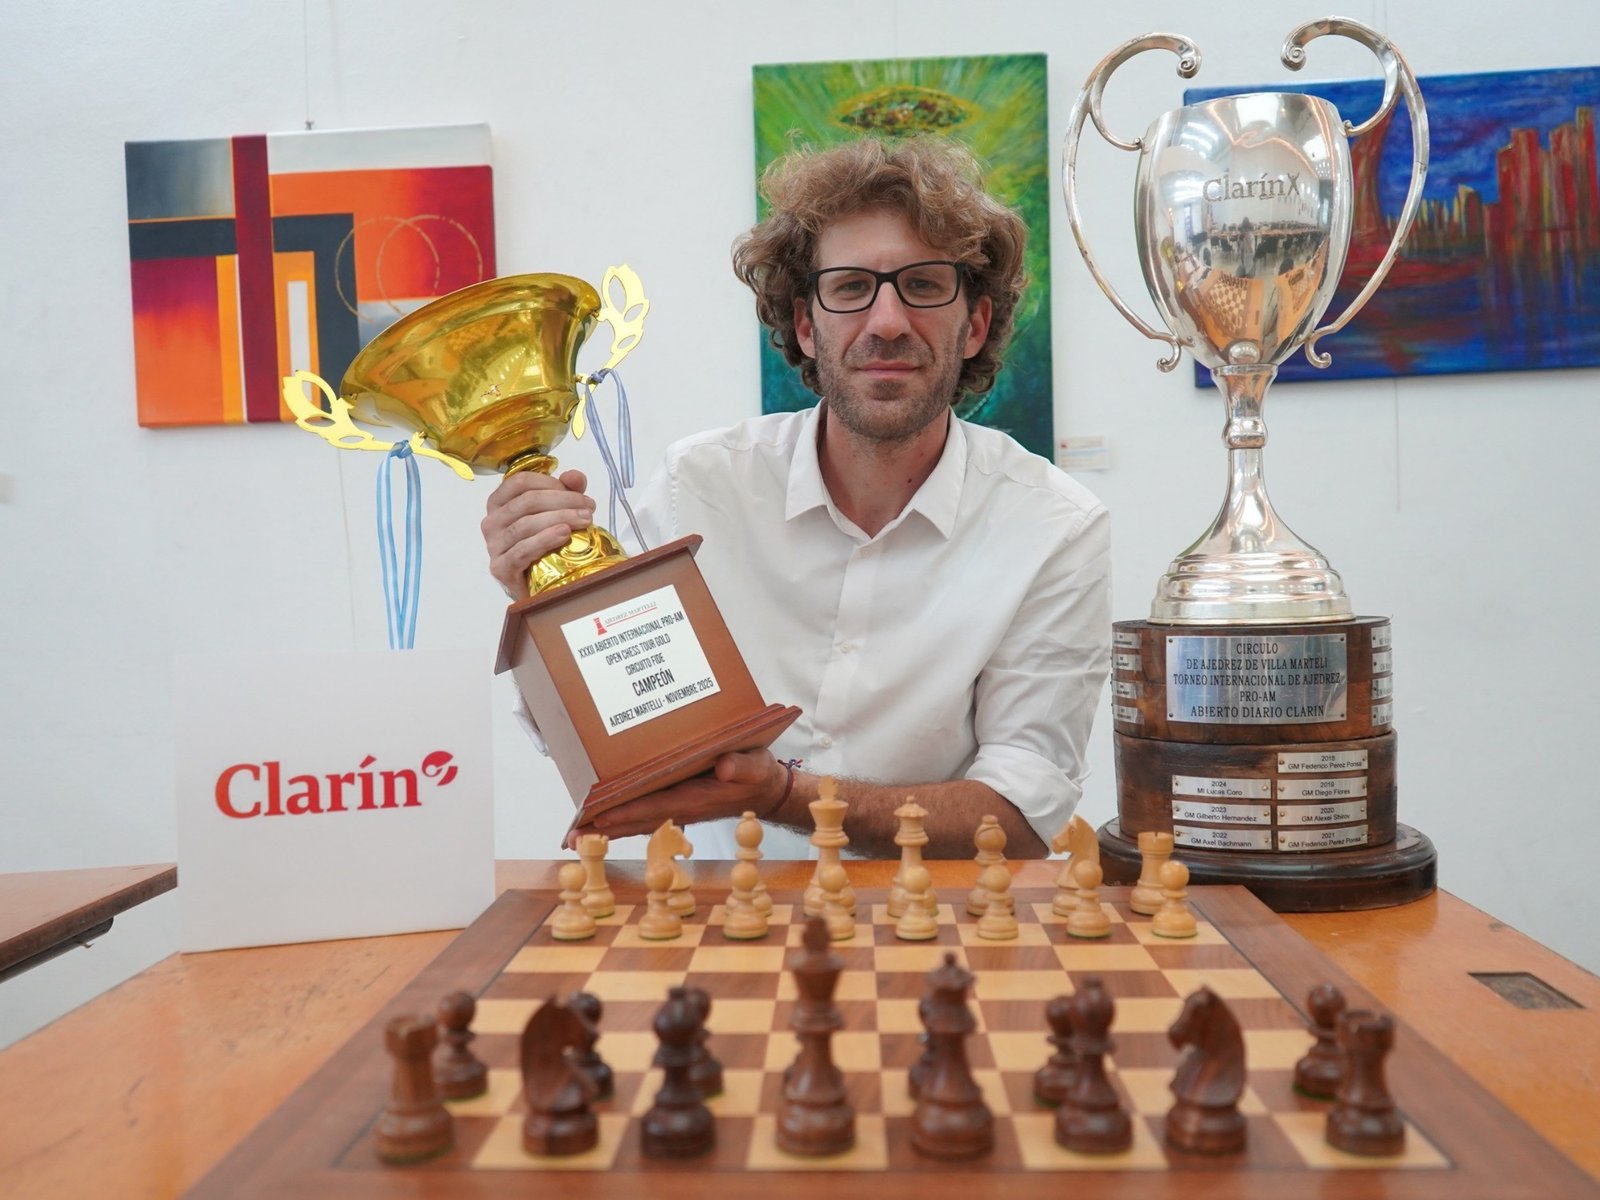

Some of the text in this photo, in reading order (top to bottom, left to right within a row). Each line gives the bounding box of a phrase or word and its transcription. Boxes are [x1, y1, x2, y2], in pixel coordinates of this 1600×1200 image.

[1203, 171, 1286, 202] Clarín
[578, 611, 685, 659] XXXII ABIERTO INTERNACIONAL PRO-AM
[605, 633, 671, 666] OPEN CHESS TOUR GOLD
[1236, 642, 1279, 655] CIRCULO
[625, 653, 666, 676] CIRCUITO FIDE
[1186, 657, 1328, 671] DE AJEDREZ DE VILLA MARTELI
[632, 668, 675, 697] CAMPEÓN
[1173, 672, 1341, 687] TORNEO INTERNACIONAL DE AJEDREZ
[609, 710, 635, 728] AJEDREZ
[634, 698, 664, 716] MARTELLI
[665, 685, 701, 704] NOVIEMBRE
[699, 677, 714, 692] 2025
[1239, 691, 1276, 702] PRO-AM
[1190, 704, 1325, 718] ABIERTO DIARIO CLARIN
[215, 755, 422, 819] Clarín
[1315, 789, 1332, 797] Diego
[1196, 812, 1220, 820] Gilberto
[1221, 813, 1257, 822] Hernandez
[1217, 839, 1252, 847] Bachmann
